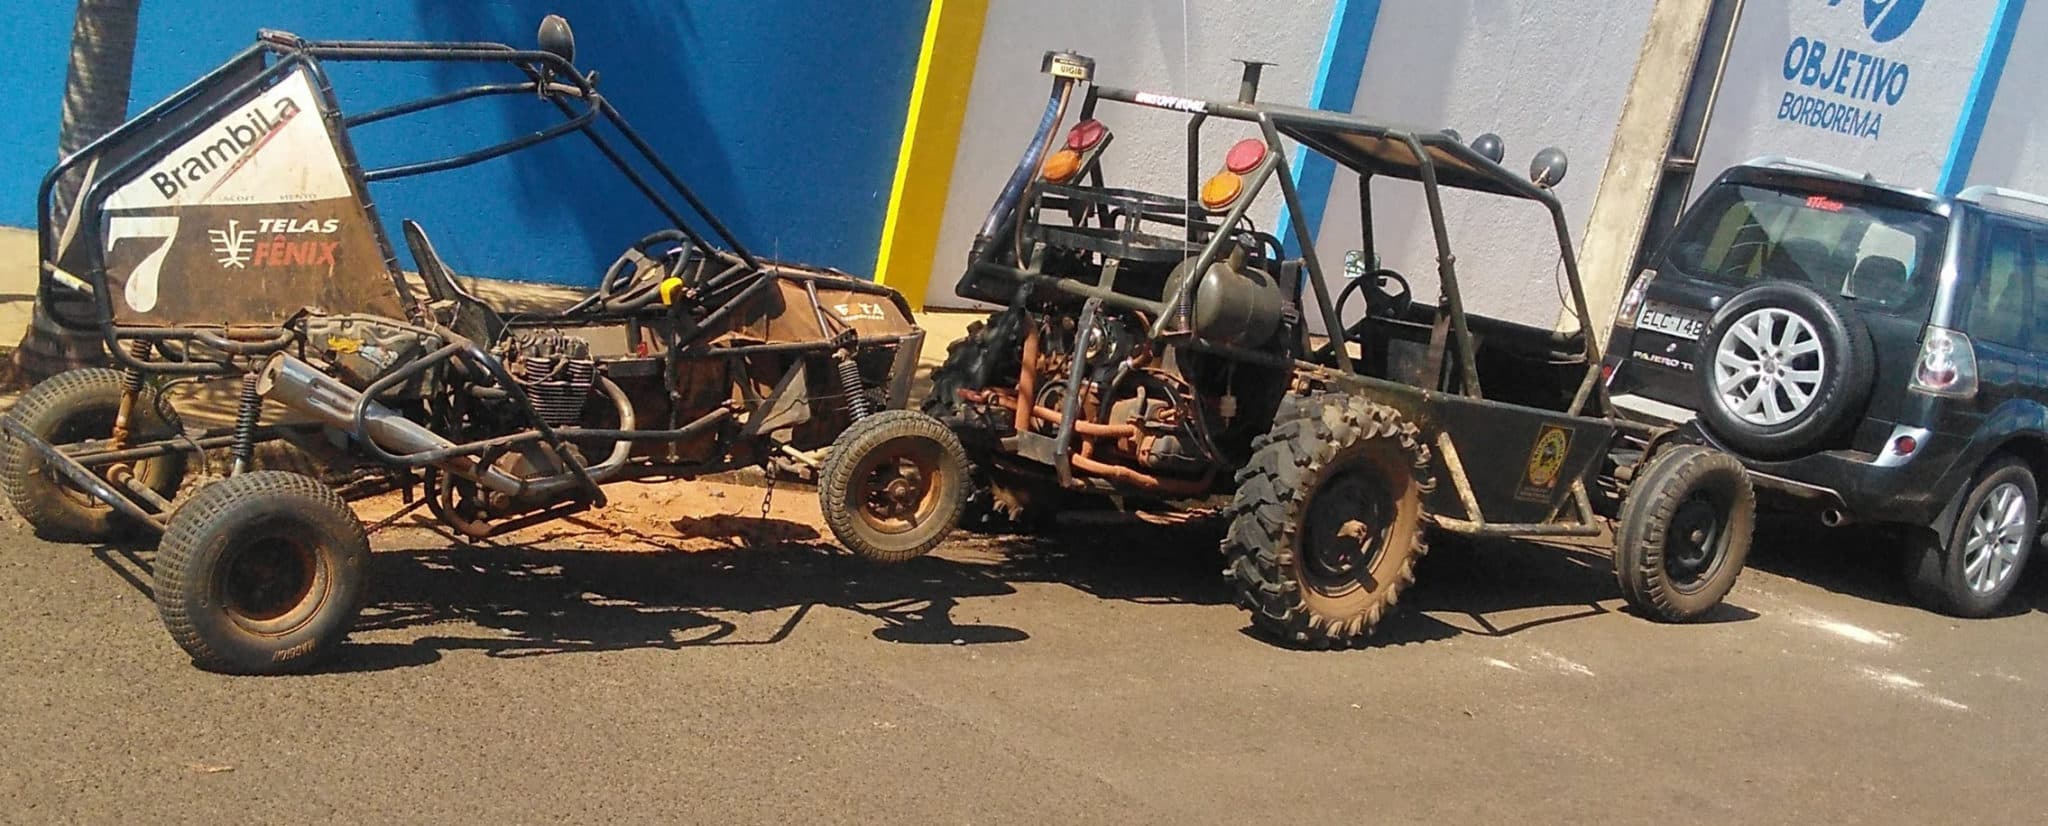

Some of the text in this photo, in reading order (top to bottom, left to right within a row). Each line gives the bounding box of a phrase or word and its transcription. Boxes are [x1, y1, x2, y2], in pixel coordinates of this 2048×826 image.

[1783, 36, 1909, 106] OBJETIVO
[1777, 91, 1883, 140] BORBOREMA
[259, 218, 340, 233] TELAS
[107, 216, 180, 313] 7
[253, 234, 341, 267] FÊNIX
[1632, 350, 1680, 368] PAJERO
